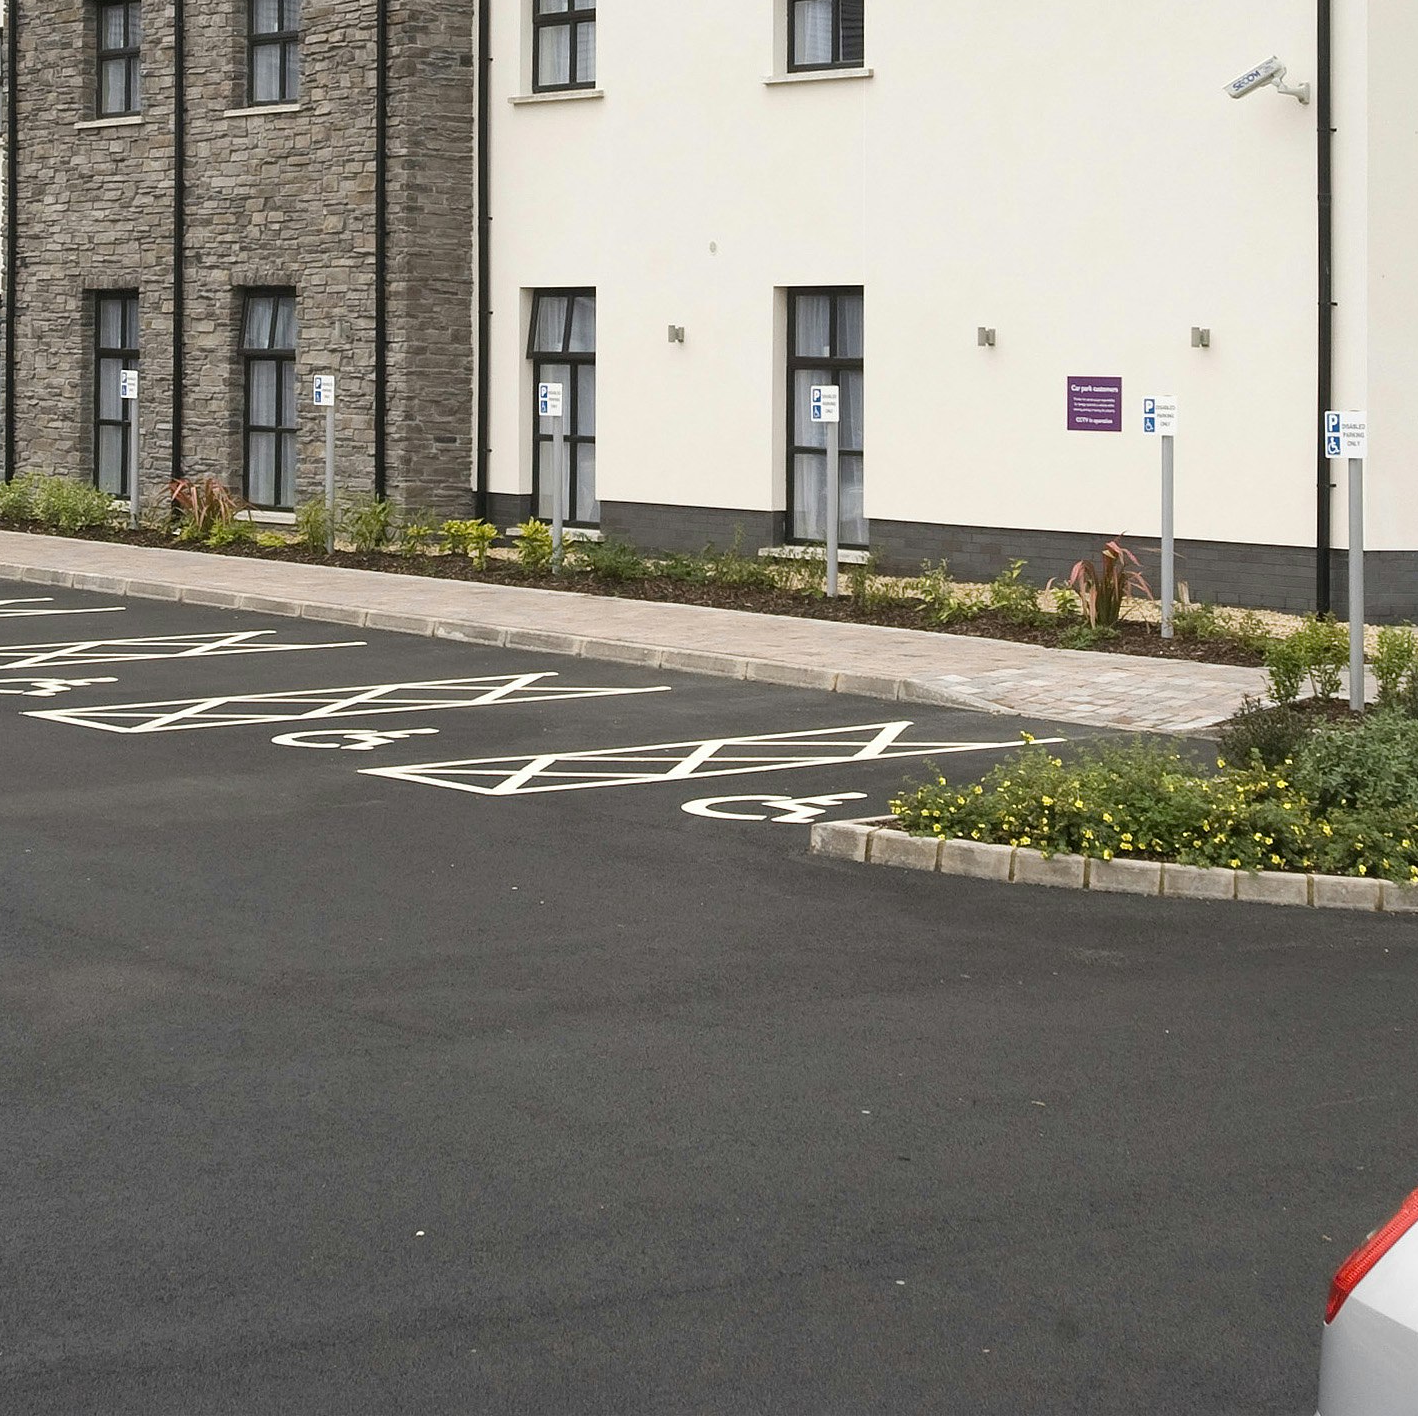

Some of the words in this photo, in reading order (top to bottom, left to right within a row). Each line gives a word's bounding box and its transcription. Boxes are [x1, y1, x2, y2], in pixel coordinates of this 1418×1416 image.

[1232, 70, 1261, 91] SECOM
[1145, 400, 1154, 413] P
[1328, 414, 1338, 432] P
